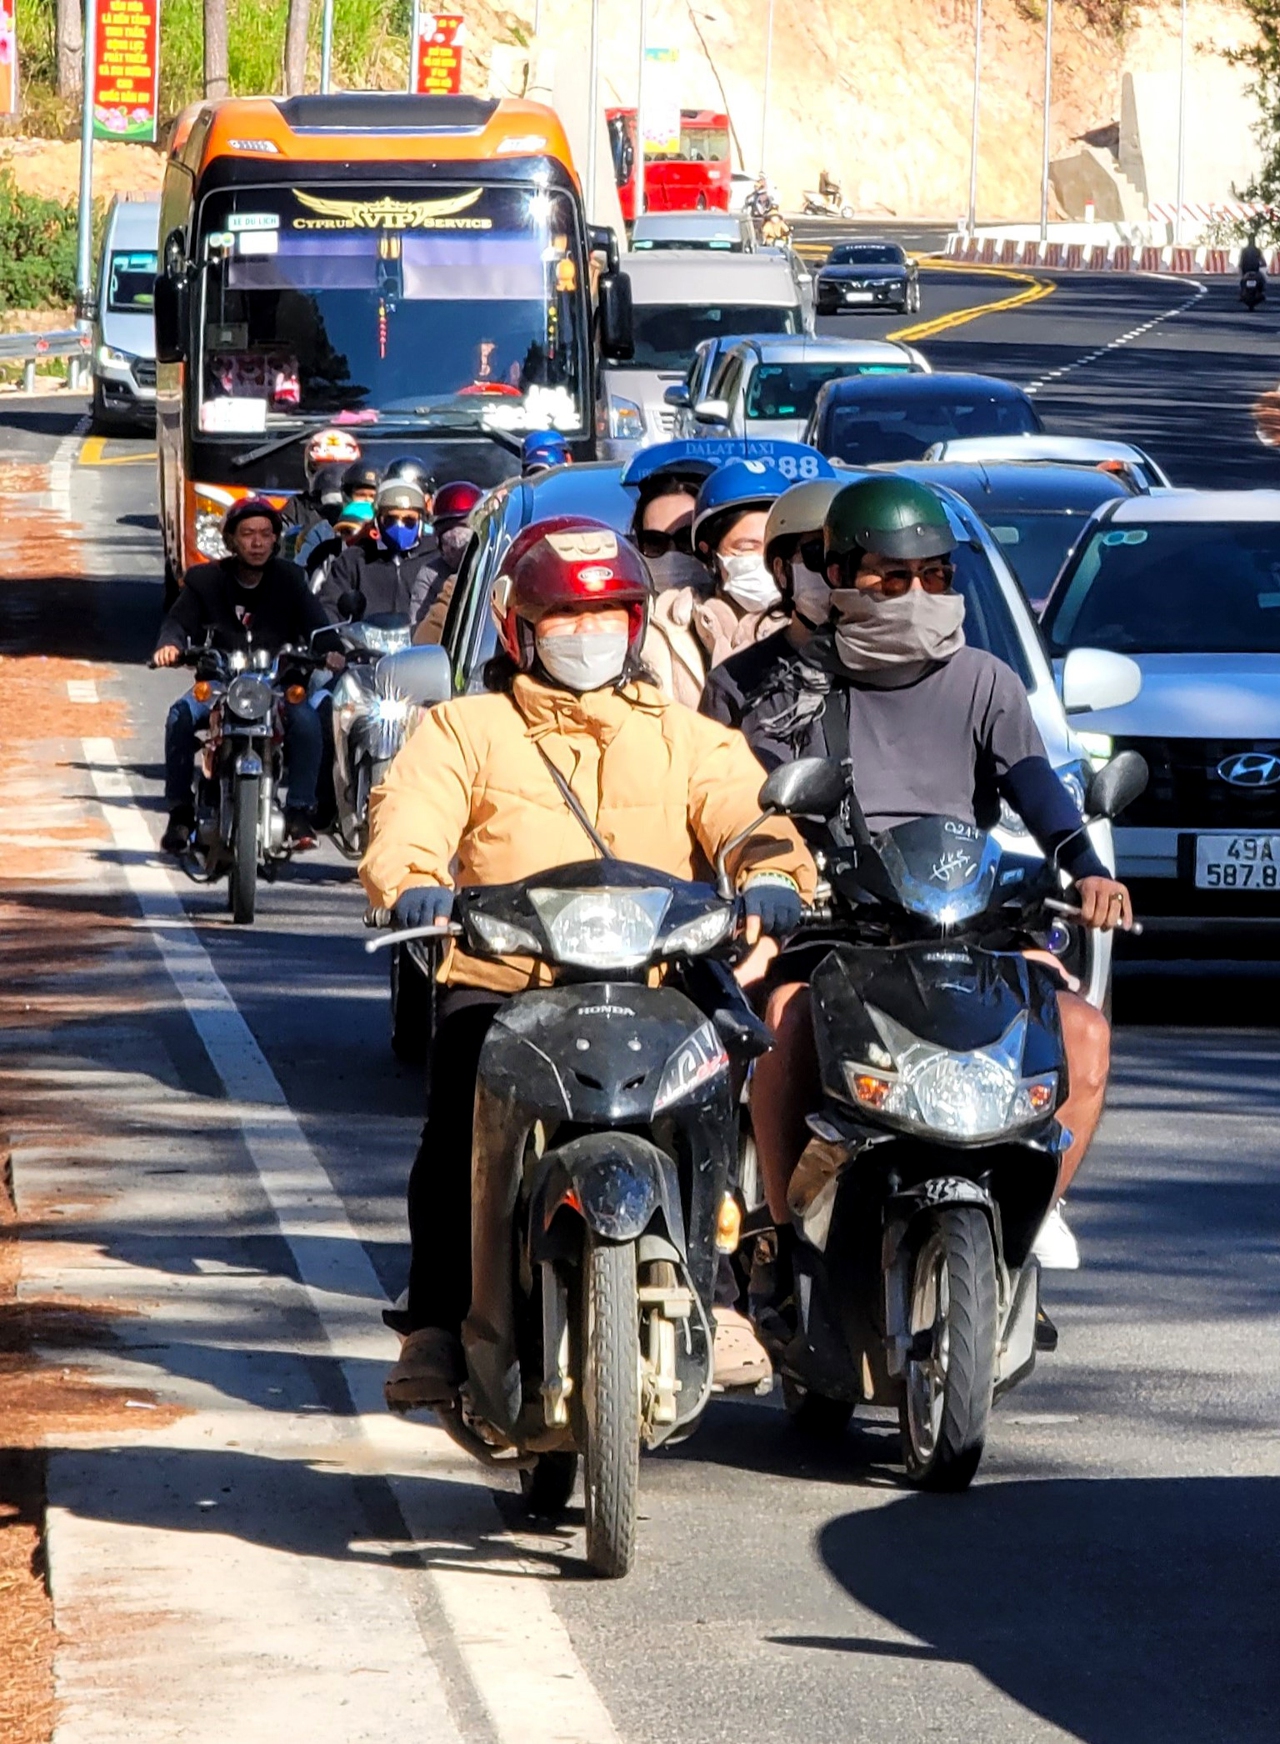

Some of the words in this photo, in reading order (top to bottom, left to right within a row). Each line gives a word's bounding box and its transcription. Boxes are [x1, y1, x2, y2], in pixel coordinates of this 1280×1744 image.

[362, 213, 414, 229] VIP
[423, 218, 493, 229] SERVICE
[685, 443, 735, 455] DALAT
[742, 443, 775, 455] TAXI
[1227, 838, 1274, 861] 49A
[578, 1005, 636, 1017] HONDA
